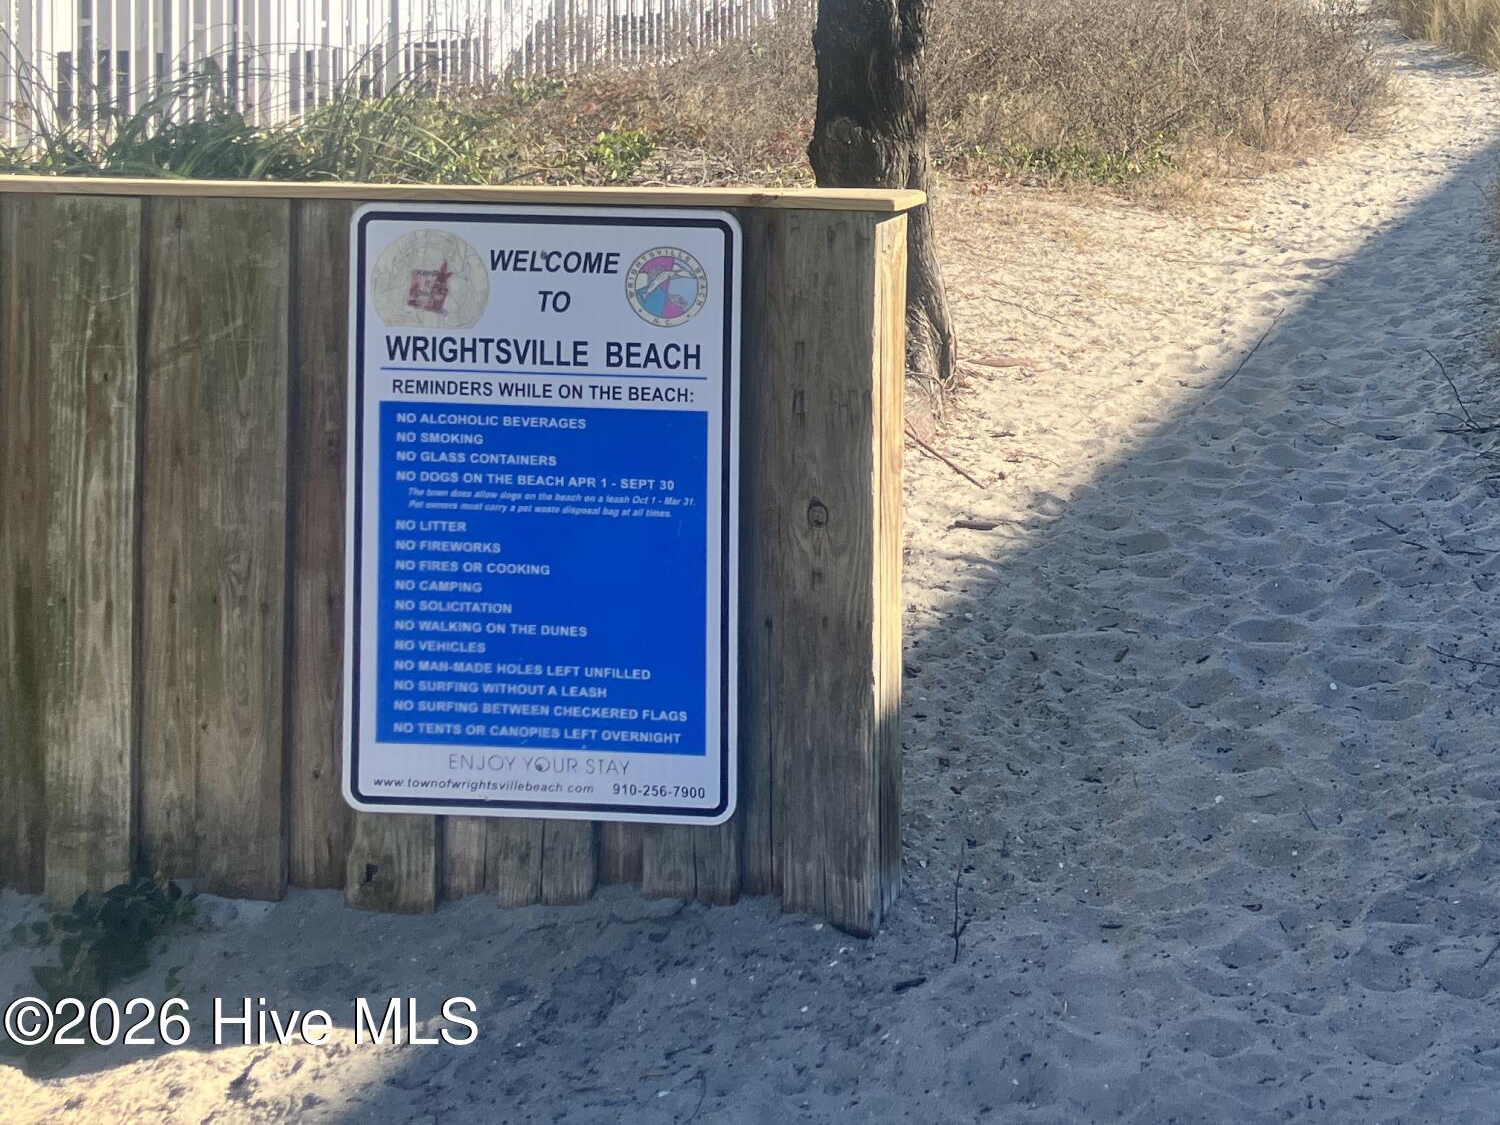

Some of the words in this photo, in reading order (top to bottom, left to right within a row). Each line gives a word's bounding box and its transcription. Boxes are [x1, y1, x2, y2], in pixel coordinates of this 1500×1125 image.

[490, 249, 620, 274] WELCOME
[538, 291, 571, 313] TO
[385, 335, 589, 367] WRIGHTSVILLE
[605, 343, 701, 370] BEACH
[393, 380, 493, 396] REMINDERS
[498, 382, 553, 399] WHILE
[558, 385, 582, 398] ON
[589, 386, 622, 400] THE
[628, 387, 694, 402] BEACH:
[397, 413, 416, 424] NO
[420, 414, 498, 427] ALCOHOLIC
[503, 416, 586, 429] BEVERAGES
[397, 433, 416, 443] NO
[421, 433, 484, 444] SMOKING
[397, 451, 416, 462] NO
[421, 452, 465, 464] GLASS
[470, 453, 556, 466] CONTAINERS
[397, 472, 416, 482] NO
[420, 472, 459, 484] DOGS
[464, 473, 483, 484] ON
[488, 474, 513, 485] THE
[517, 475, 564, 487] BEACH
[568, 476, 596, 488] APR
[601, 478, 606, 488] 1
[621, 479, 655, 491] SEPT
[660, 480, 674, 491] 30
[409, 488, 424, 496] The
[501, 491, 521, 501] dogs
[555, 493, 581, 501] beach
[563, 506, 600, 516] disposal
[397, 520, 416, 531] NO
[420, 521, 466, 532] LITTER
[396, 540, 416, 550] NO
[420, 541, 501, 553] FIREWORKS
[396, 560, 416, 571] NO
[419, 561, 458, 572] FIRES
[464, 562, 483, 573] OR
[487, 563, 550, 575] COOKING
[396, 580, 415, 590] NO
[419, 580, 482, 593] CAMPING
[396, 600, 415, 611] NO
[419, 601, 512, 614] SOLICITATION
[395, 620, 415, 631] NO
[419, 621, 482, 633] WALKING
[487, 622, 506, 634] ON
[511, 624, 536, 635] THE
[541, 625, 587, 637] DUNES
[395, 641, 414, 651] NO
[419, 641, 486, 653] VEHICLES
[394, 660, 414, 671] NO
[418, 661, 492, 674] MAN-MADE
[497, 663, 543, 676] HOLES
[547, 665, 580, 677] LEFT
[585, 666, 650, 680] UNFILLED
[394, 680, 414, 691] NO
[418, 681, 478, 693] SURFING
[483, 683, 544, 695] WITHOUT
[548, 685, 557, 696] A
[561, 685, 607, 698] LEASH
[394, 700, 413, 711] NO
[418, 701, 478, 714] SURFING
[483, 703, 549, 716] BETWEEN
[554, 705, 638, 719] CHECKERED
[643, 709, 687, 722] FLAGS
[393, 722, 413, 733] NO
[418, 723, 461, 735] TENTS
[466, 725, 485, 736] OR
[490, 725, 560, 739] CANOPIES
[564, 728, 597, 740] LEFT
[601, 729, 681, 743] OVERNIGHT
[449, 754, 515, 771] ENJOY
[525, 757, 577, 773] YOUR
[585, 758, 630, 775] STAY
[374, 777, 594, 794] wwwtownofwrightsvillebeachcom
[613, 783, 705, 799] 910-256-7900
